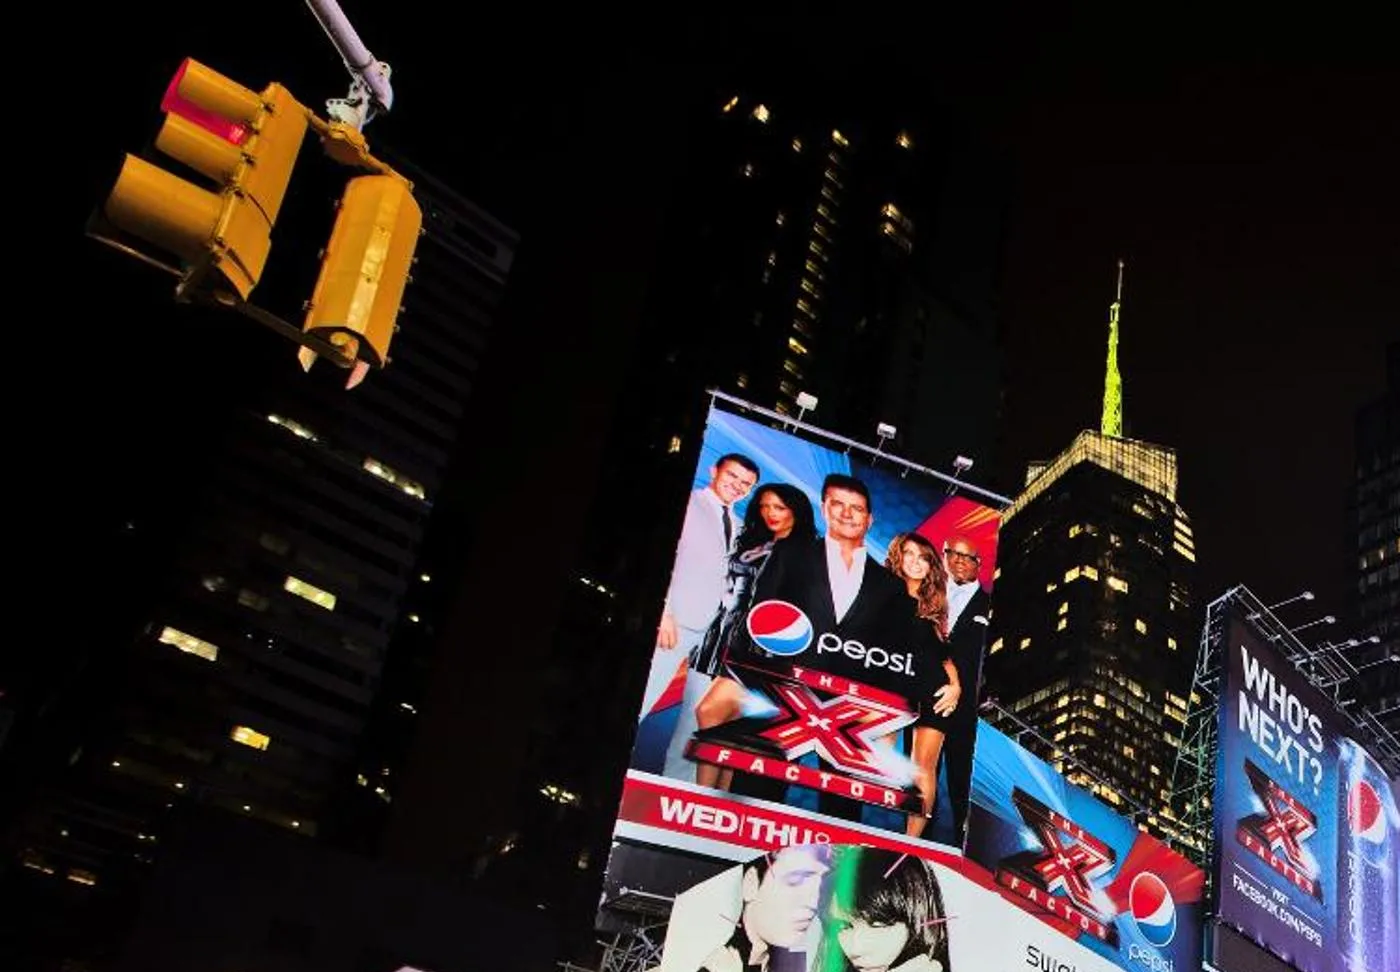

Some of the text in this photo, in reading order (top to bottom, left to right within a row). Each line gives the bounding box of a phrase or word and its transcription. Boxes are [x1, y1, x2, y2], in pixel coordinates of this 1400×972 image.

[792, 666, 860, 696] THE
[816, 632, 911, 676] pepsi
[1241, 645, 1324, 753] WHO'S
[1239, 691, 1322, 796] NEXT?
[716, 750, 897, 806] FACTOR
[1049, 811, 1084, 839] THE
[1010, 876, 1107, 940] FACTOR
